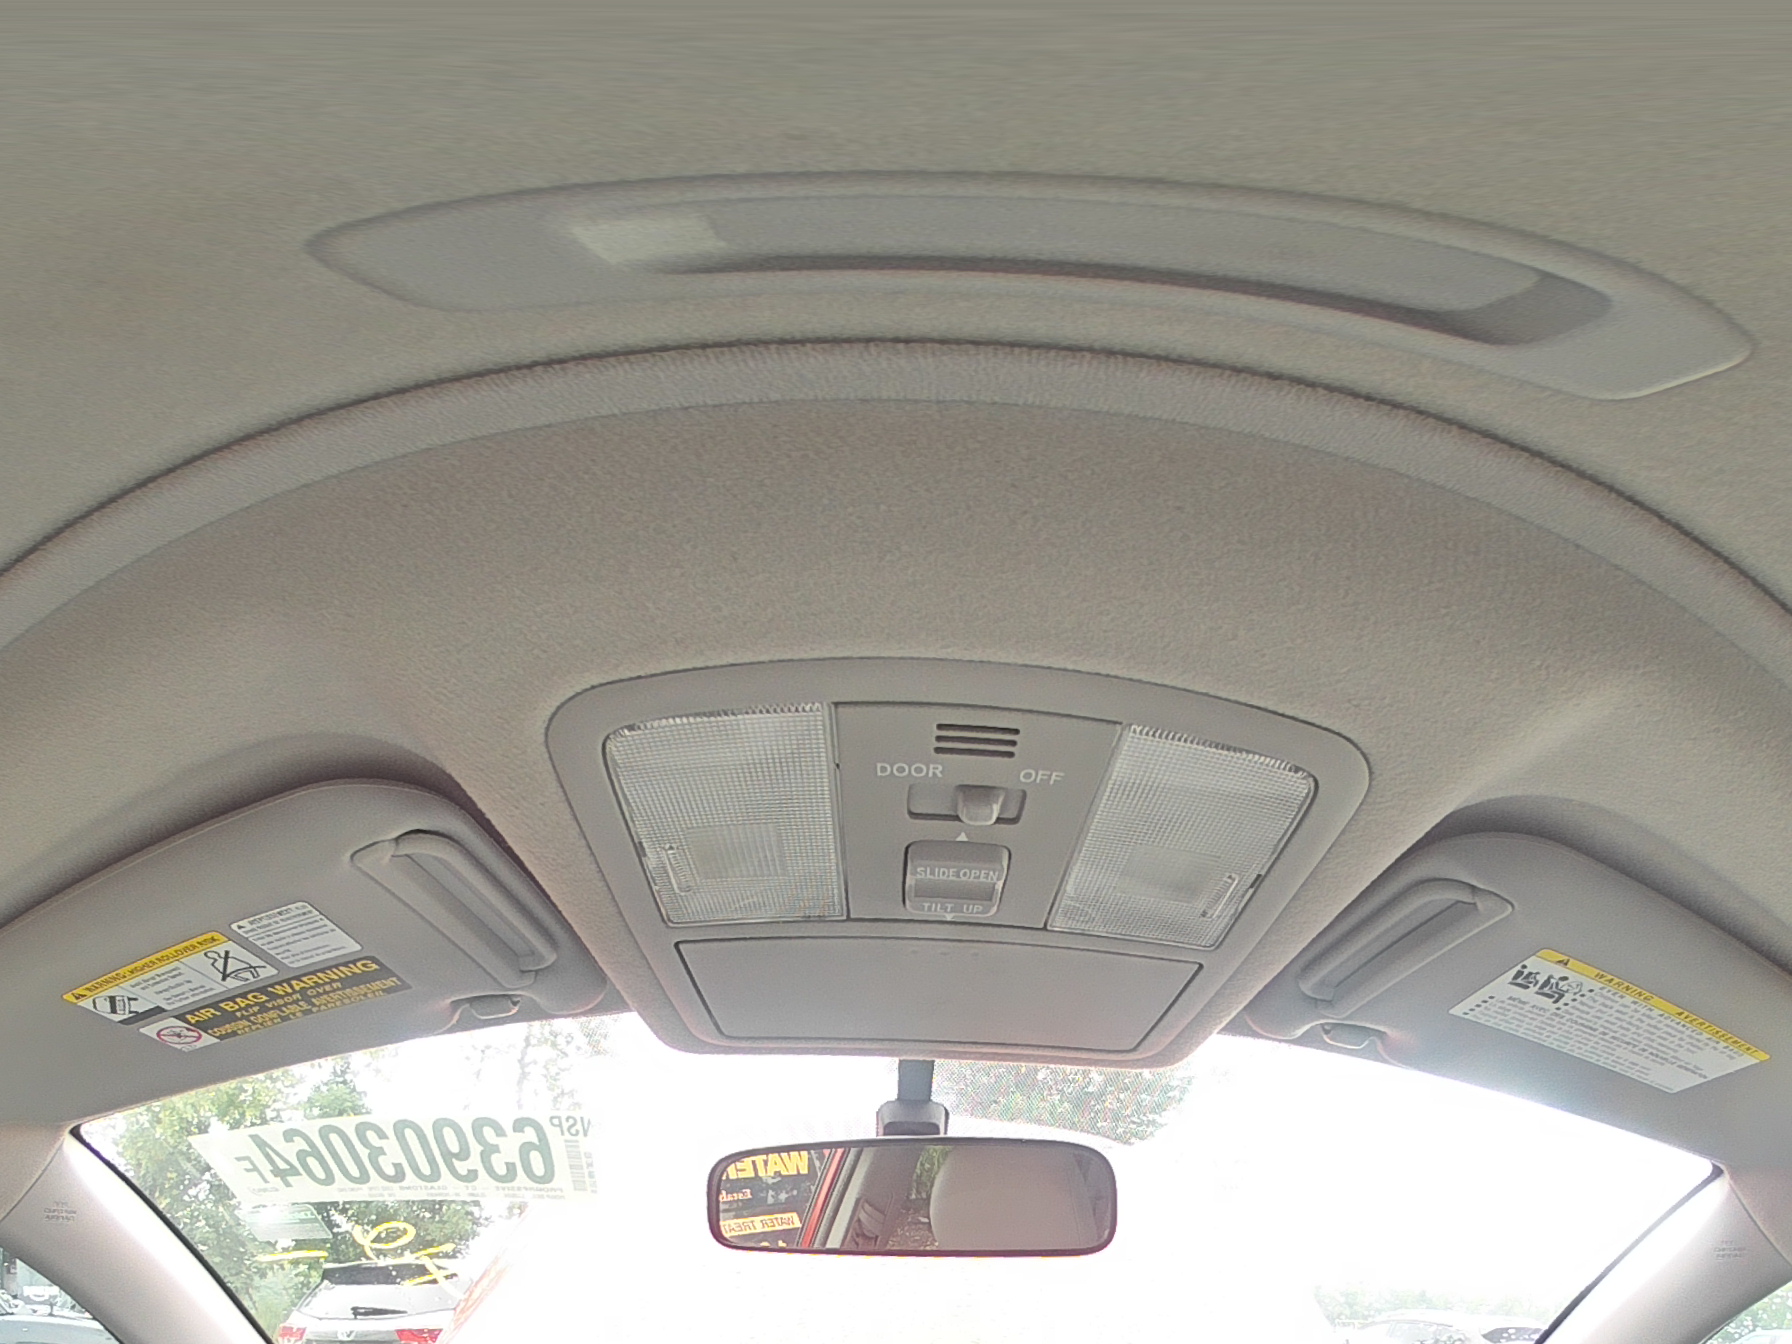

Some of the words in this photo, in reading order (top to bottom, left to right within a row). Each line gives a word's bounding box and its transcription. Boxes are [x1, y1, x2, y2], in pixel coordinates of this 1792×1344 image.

[876, 763, 943, 778] DOOR
[1019, 769, 1065, 785] OFF
[916, 867, 957, 880] SLIDE
[959, 869, 999, 882] OPEN
[922, 902, 955, 913] TILT
[963, 904, 983, 914] UP
[185, 1006, 220, 1024] AIR
[219, 992, 270, 1012] BAG
[267, 960, 380, 997] WARNING
[1594, 972, 1654, 1001] WARNING
[236, 1005, 261, 1019] FLIP
[265, 993, 302, 1009] VISOR
[307, 981, 343, 997] OVER
